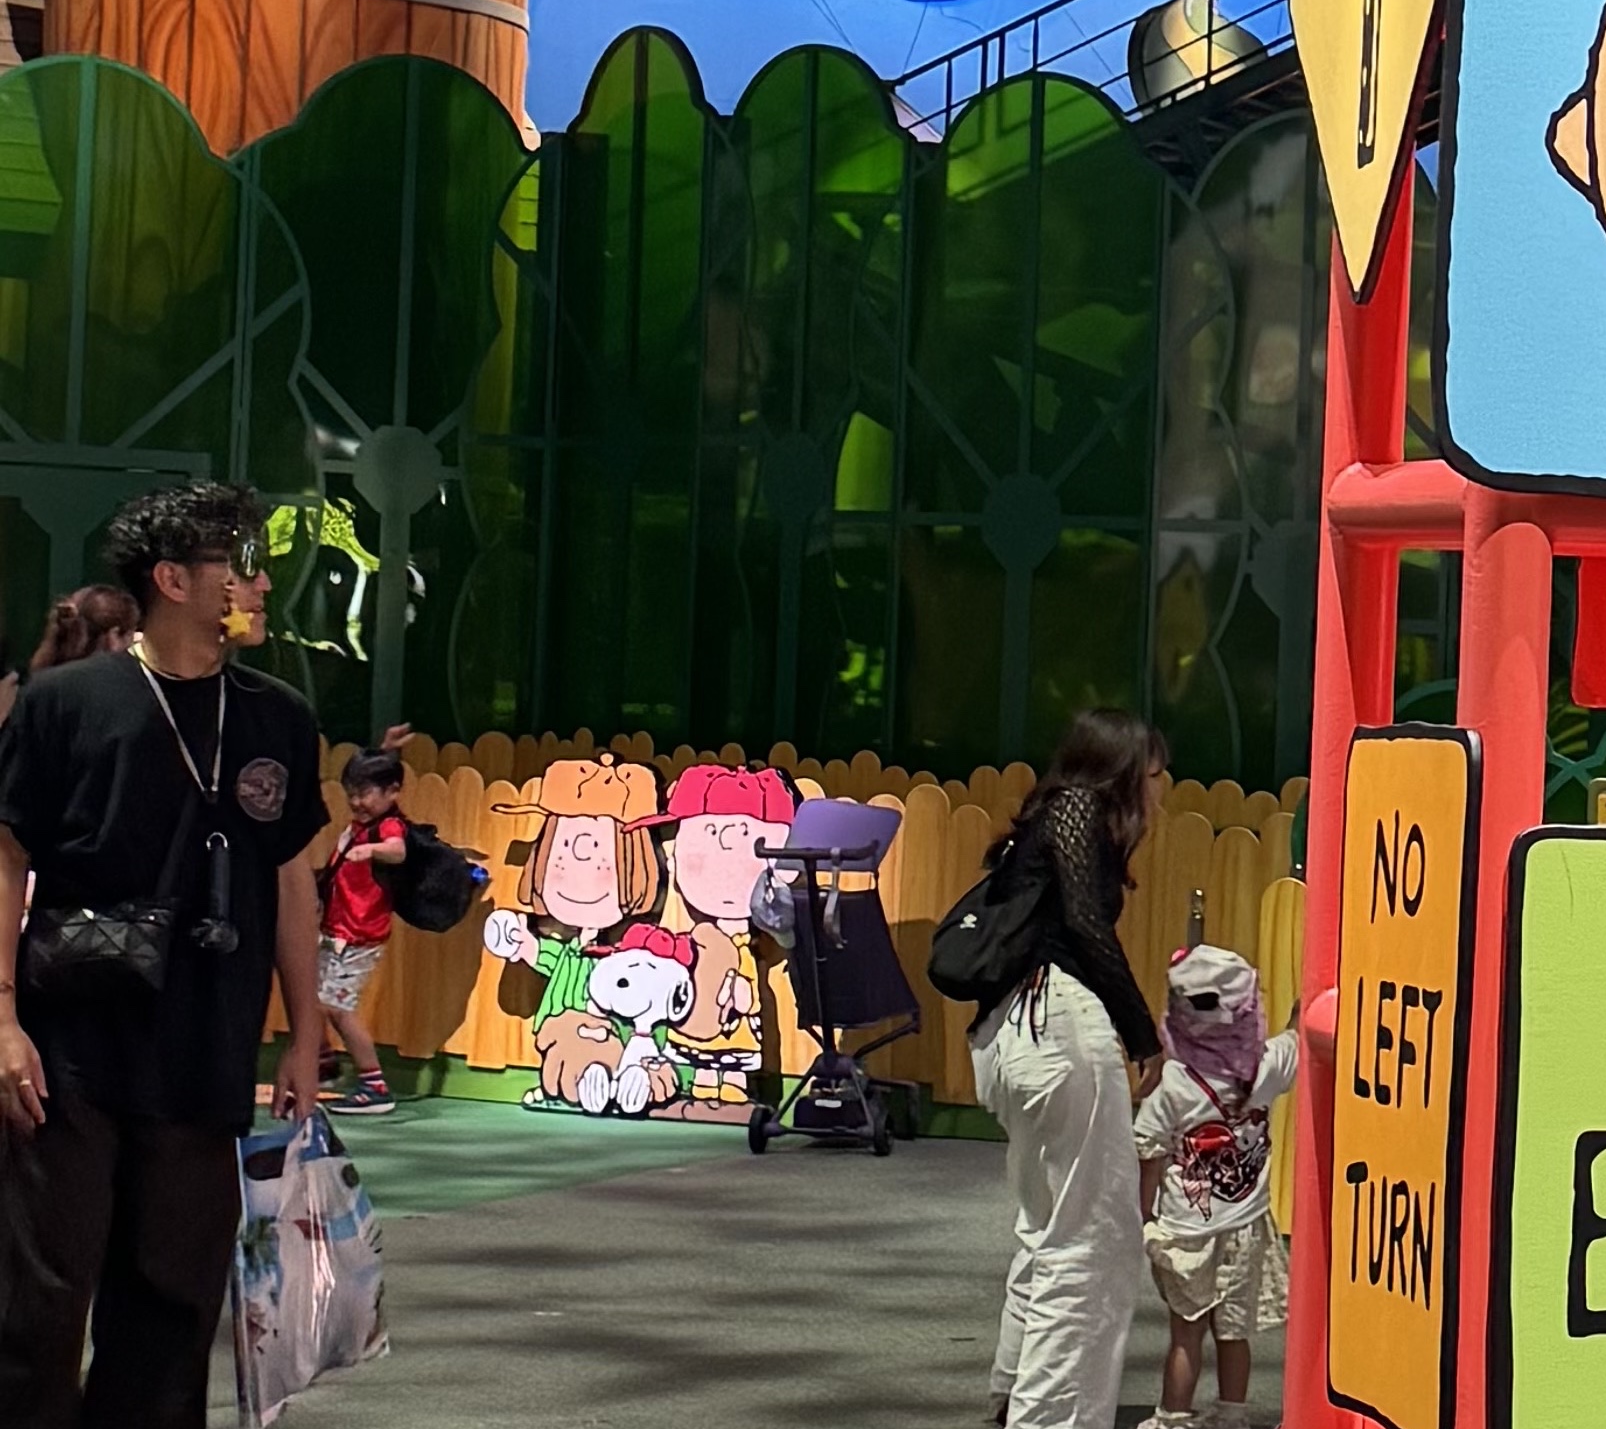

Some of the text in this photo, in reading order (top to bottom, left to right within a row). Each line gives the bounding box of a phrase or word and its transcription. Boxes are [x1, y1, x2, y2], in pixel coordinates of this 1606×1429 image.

[1369, 809, 1426, 924] NO
[1353, 976, 1443, 1110] LEFT
[1346, 1160, 1437, 1311] TURN
